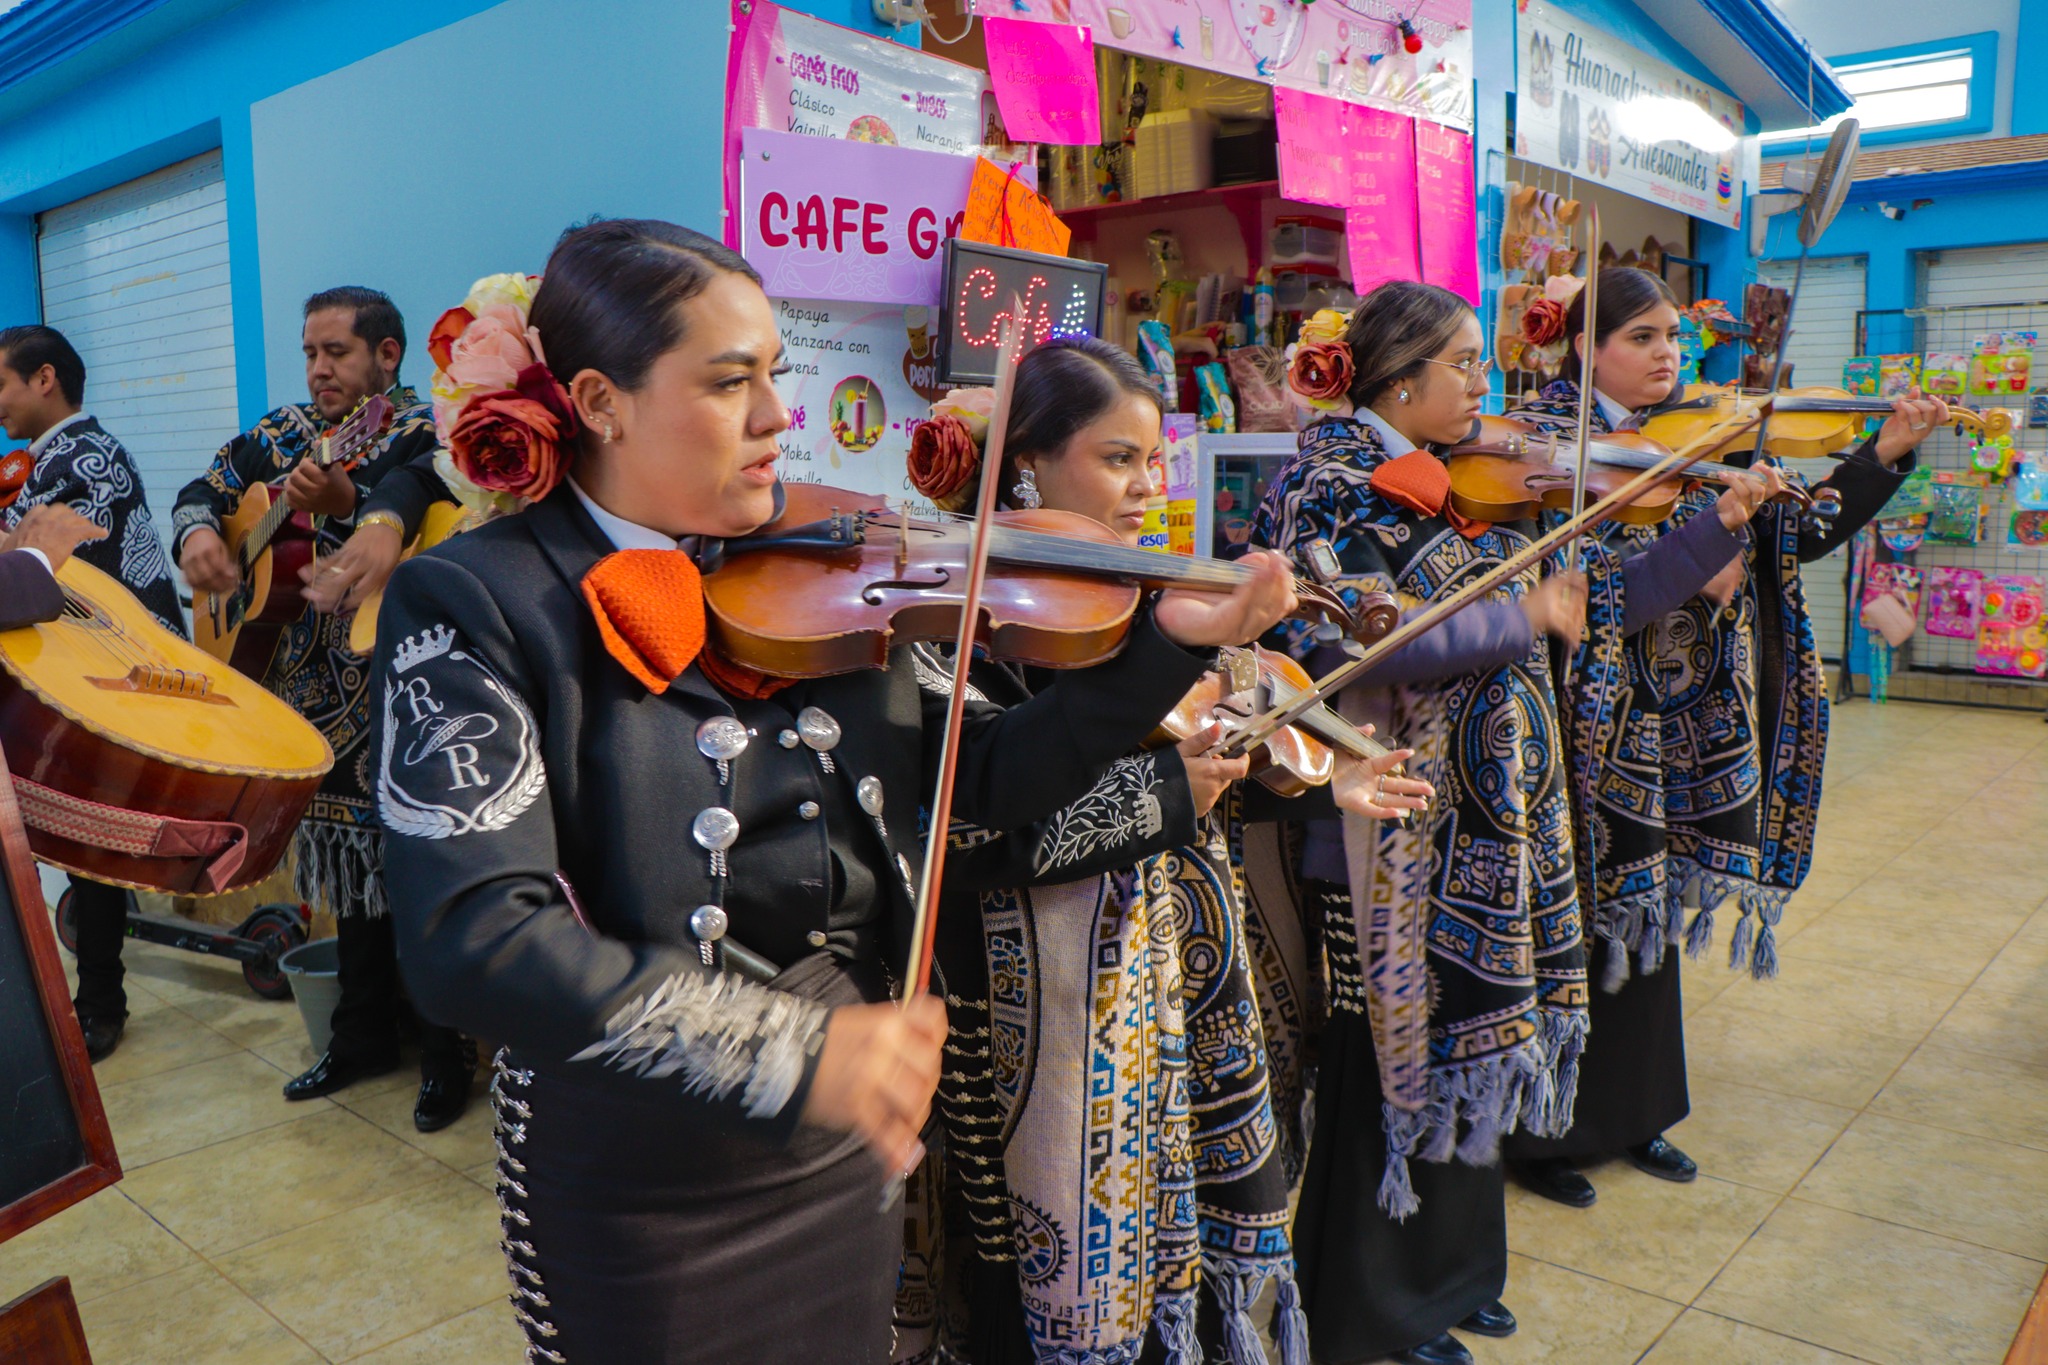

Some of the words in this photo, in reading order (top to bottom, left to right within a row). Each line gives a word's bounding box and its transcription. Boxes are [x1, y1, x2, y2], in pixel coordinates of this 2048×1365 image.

[1351, 26, 1370, 50] Hot
[789, 89, 836, 117] Clásico
[916, 124, 964, 154] Naranja
[759, 191, 890, 255] CAFE
[780, 300, 830, 328] Papaya
[780, 327, 843, 352] Manzana
[848, 340, 871, 354] con
[780, 356, 820, 375] Avena
[778, 443, 812, 461] Moka
[404, 677, 444, 726] R
[439, 742, 491, 791] R
